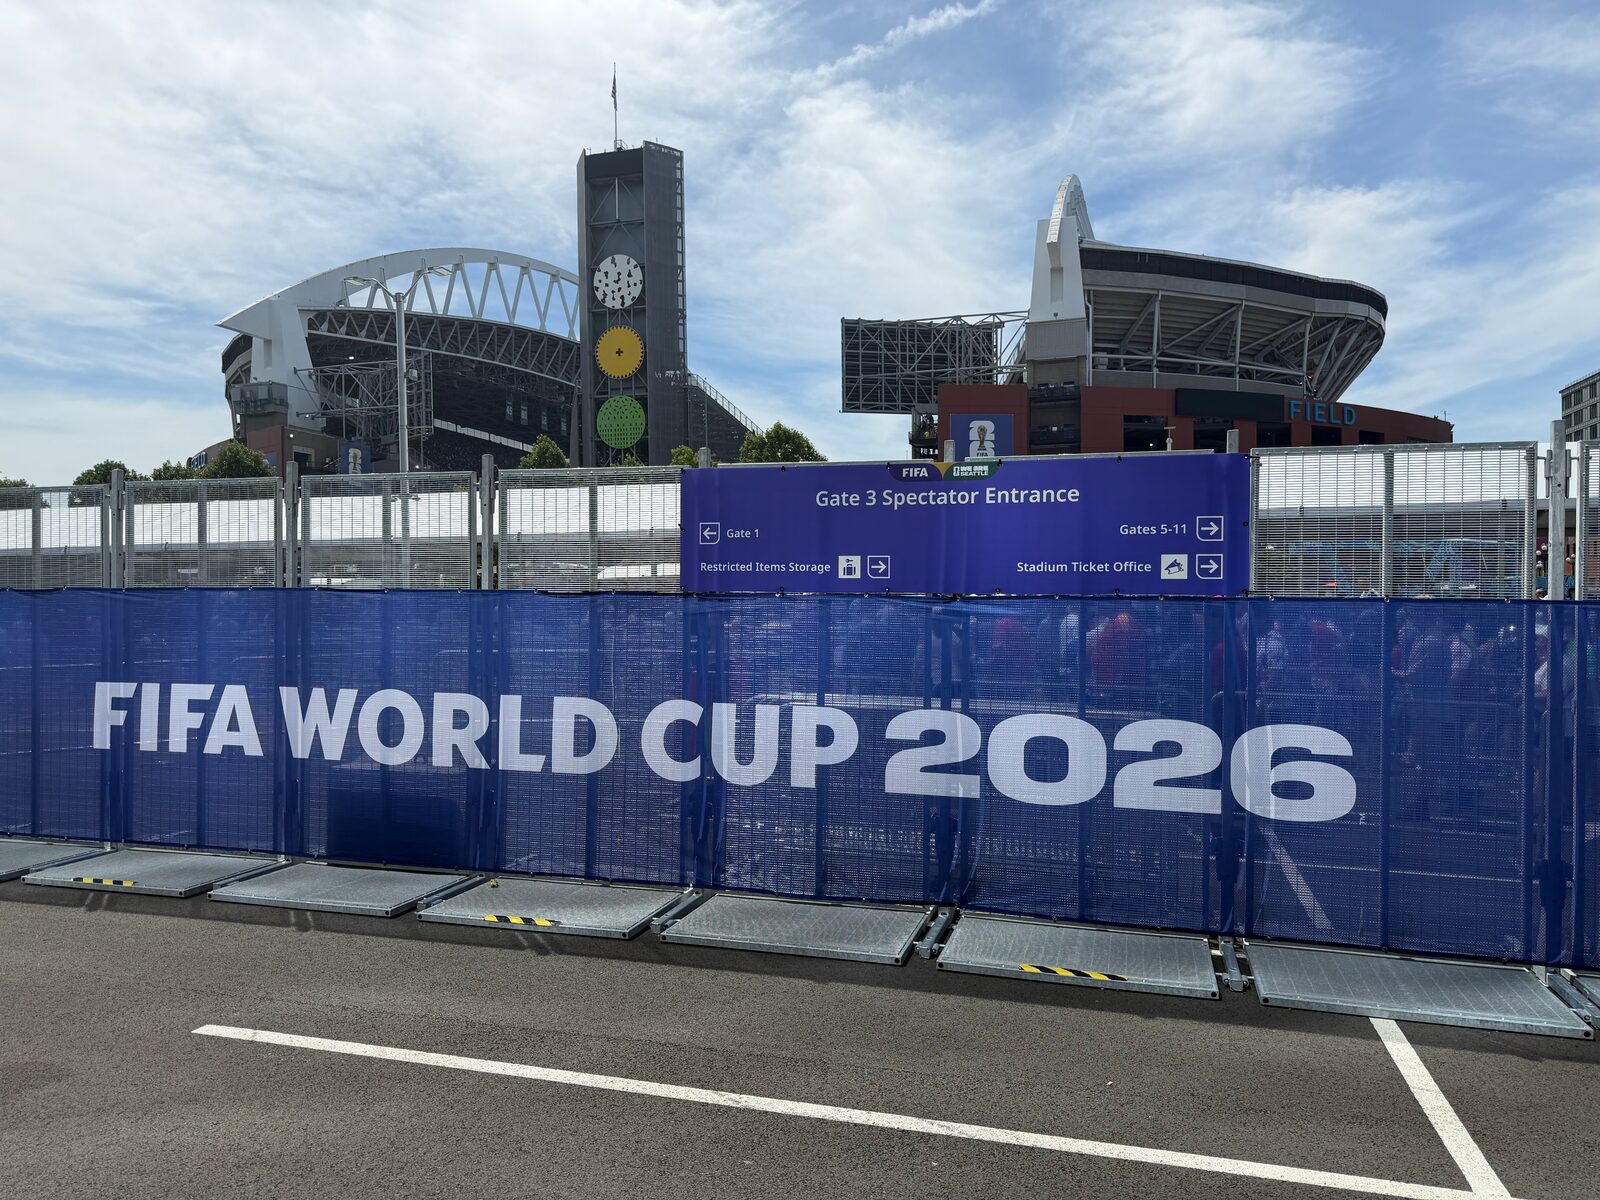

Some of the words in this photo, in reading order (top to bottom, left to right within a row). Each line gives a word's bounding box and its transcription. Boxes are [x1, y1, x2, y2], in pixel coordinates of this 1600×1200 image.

[1289, 400, 1358, 425] FIELD
[902, 467, 929, 478] FIFA
[815, 490, 860, 507] Gate
[865, 489, 877, 506] 3
[882, 489, 981, 510] Spectator
[985, 487, 1080, 504] Entrance
[726, 528, 751, 539] Gate
[754, 528, 760, 538] 1
[1119, 523, 1157, 536] Gates
[1160, 523, 1187, 535] 5-11
[700, 561, 753, 573] Restricted
[755, 562, 786, 573] Items
[788, 562, 831, 576] Storage
[1016, 561, 1068, 573] Stadium
[1071, 561, 1110, 573] Ticket
[1113, 561, 1152, 573] Office
[93, 681, 264, 757] FIFA
[278, 686, 620, 775] WORLD
[641, 699, 859, 788] CUP
[884, 708, 1357, 822] 2026
